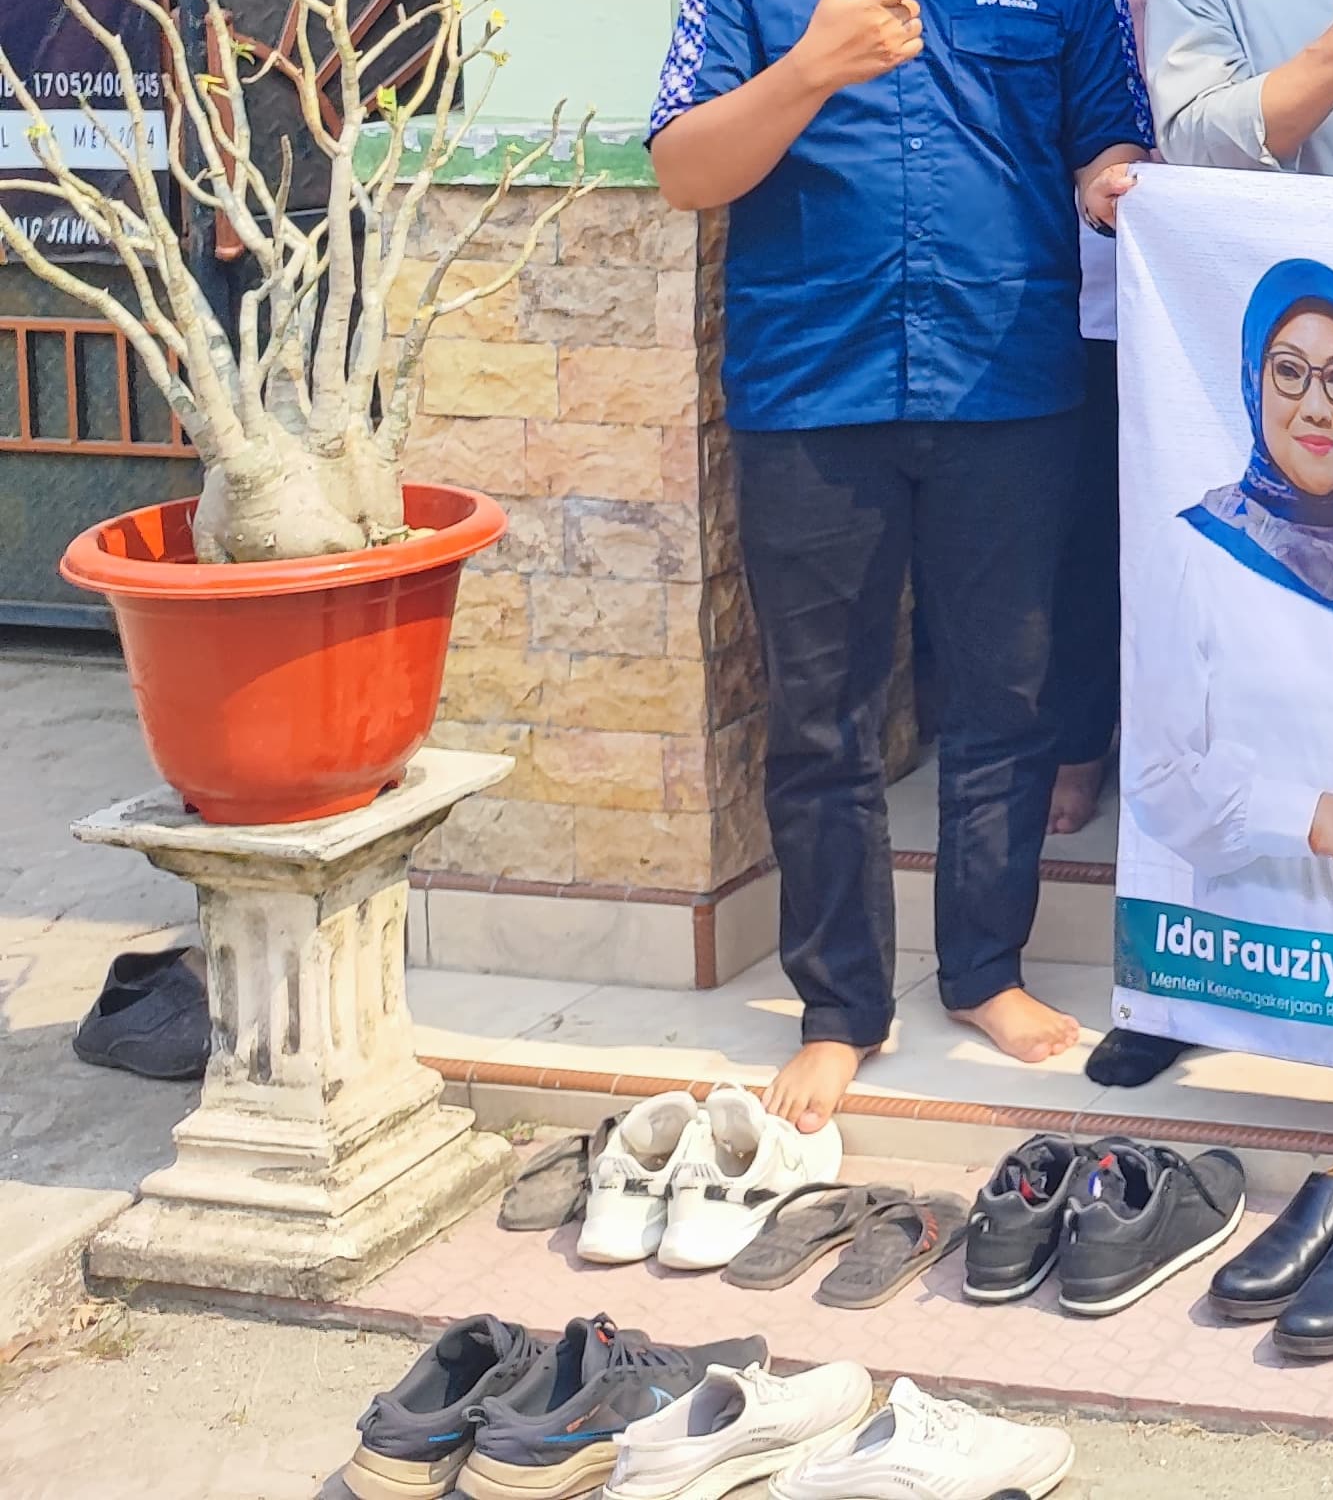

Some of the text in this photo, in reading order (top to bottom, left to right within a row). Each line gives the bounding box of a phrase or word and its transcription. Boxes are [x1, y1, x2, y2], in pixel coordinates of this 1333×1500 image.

[1154, 912, 1216, 963] Ida
[1150, 971, 1206, 995] Menteri
[1206, 979, 1324, 1018] Ketenagakerjaan
